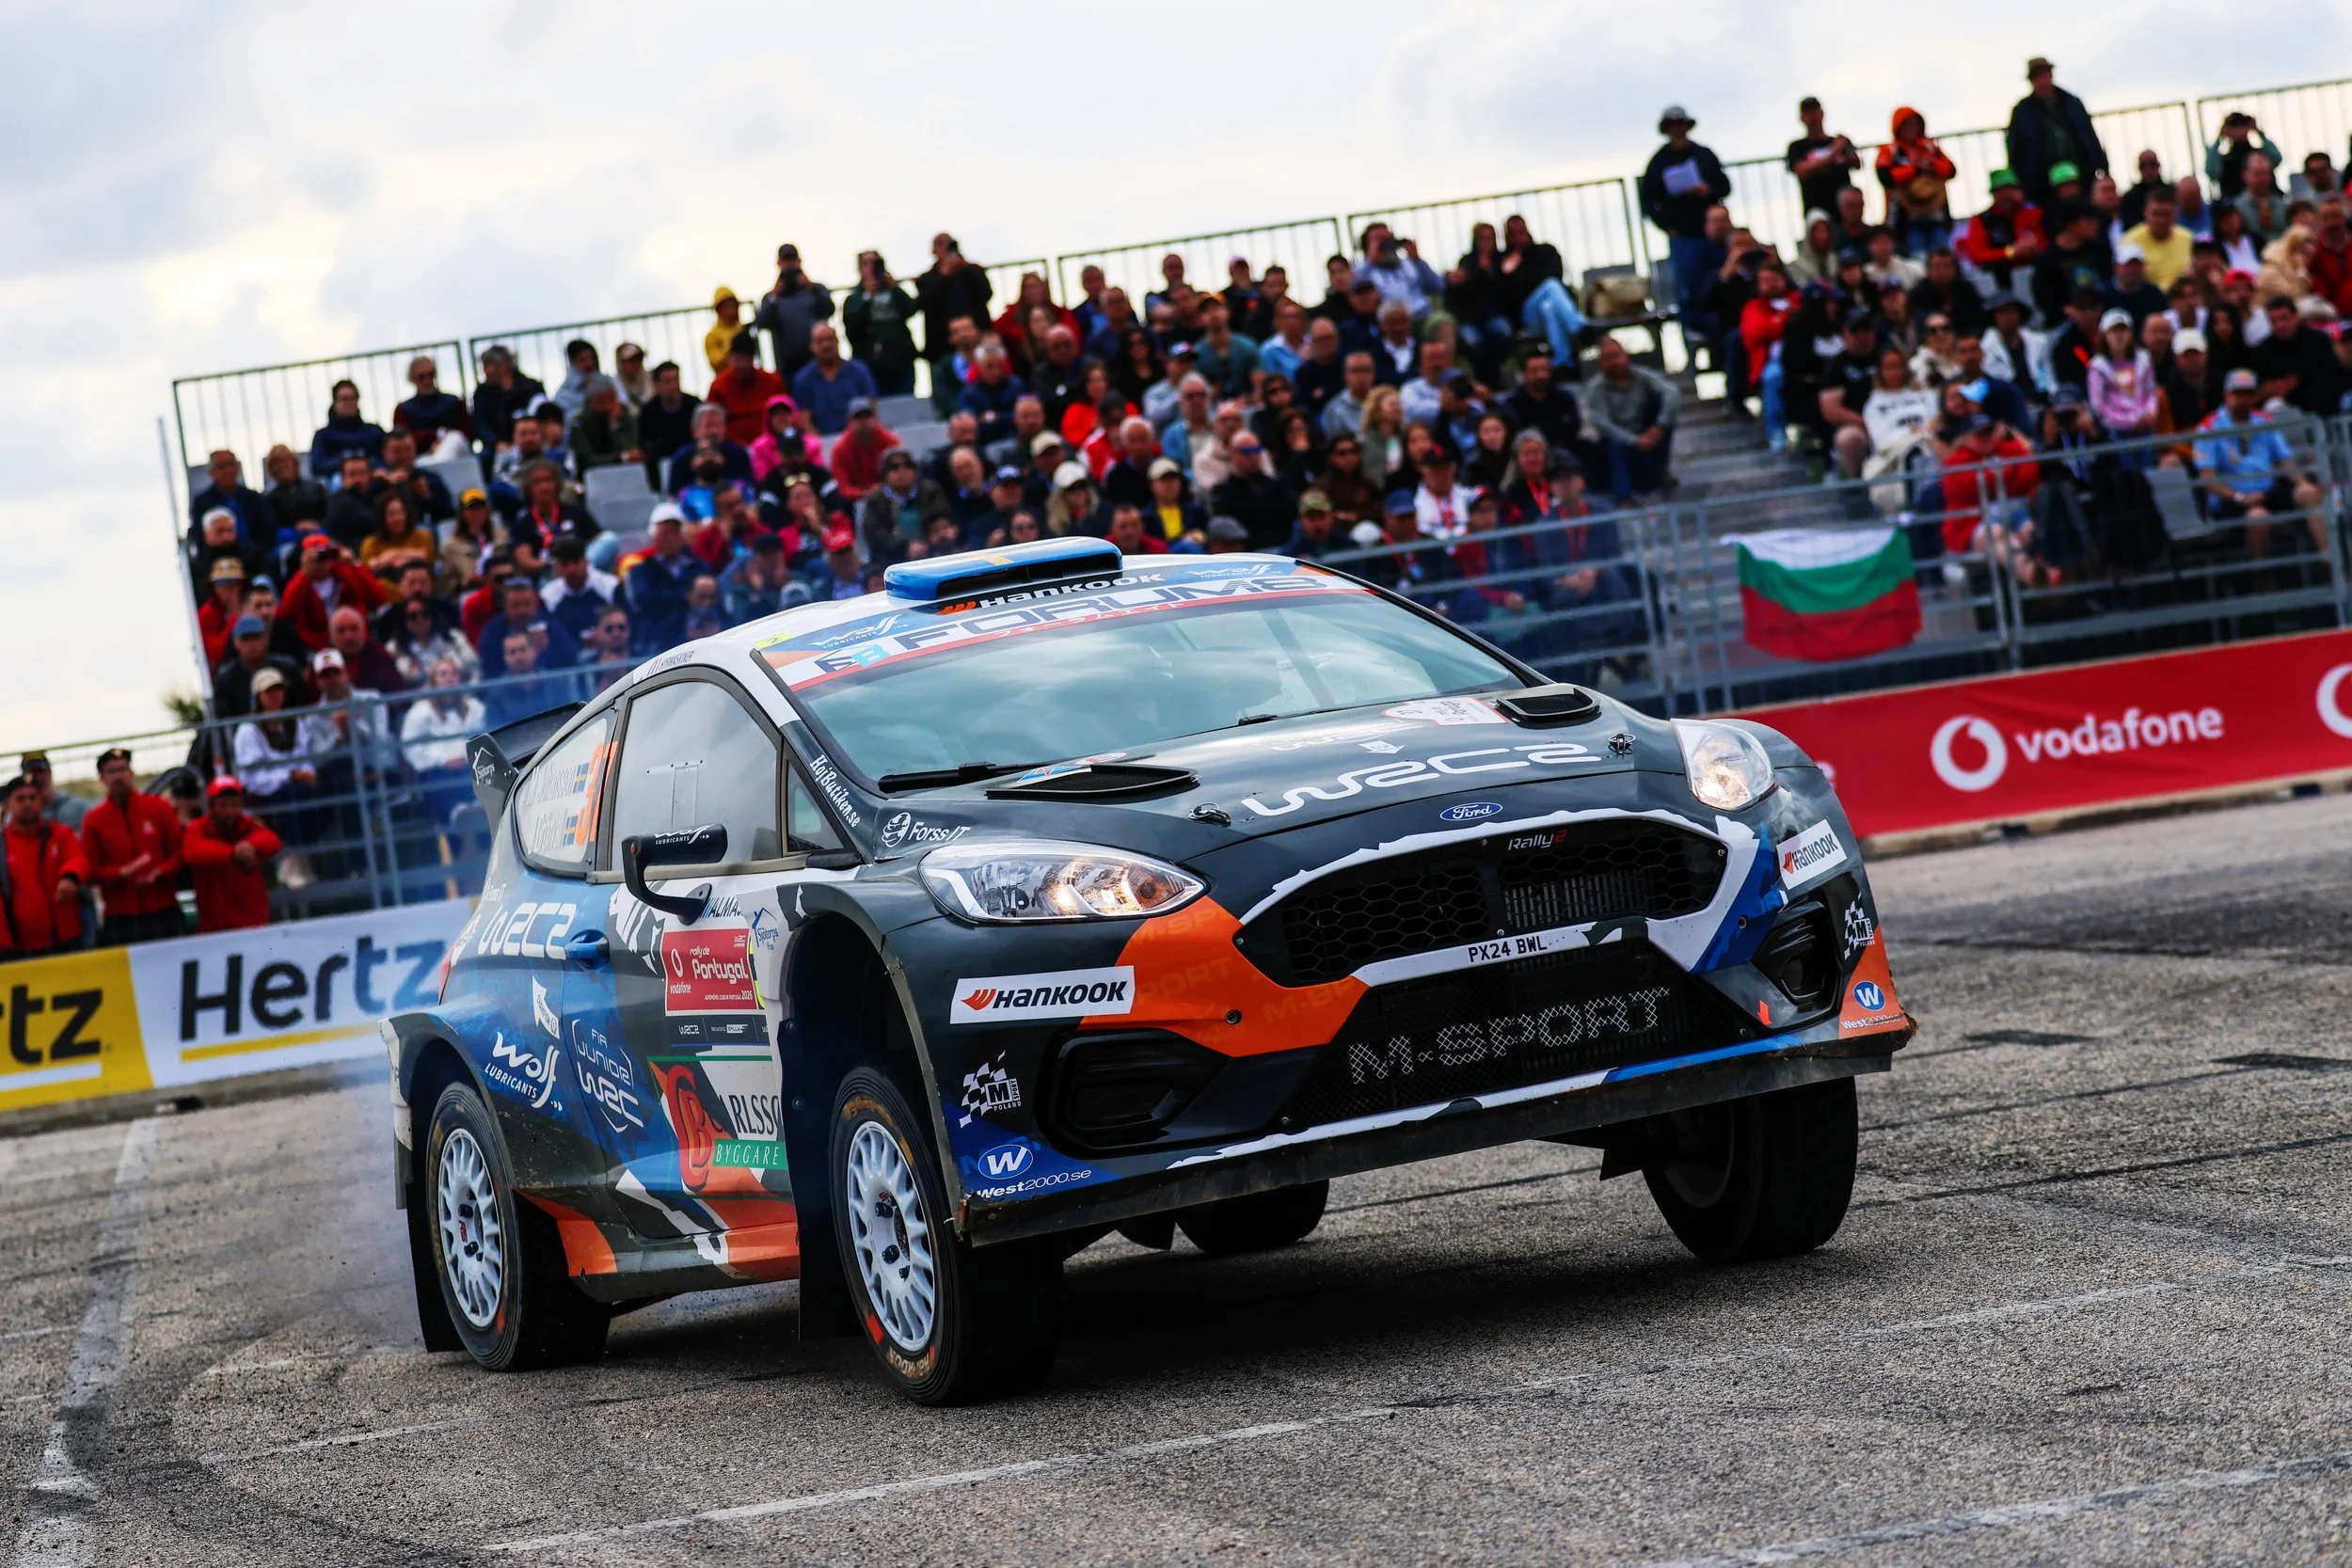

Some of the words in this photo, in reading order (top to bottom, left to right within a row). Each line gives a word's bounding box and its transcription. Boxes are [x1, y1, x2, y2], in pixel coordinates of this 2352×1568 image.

[894, 577, 1327, 651] FORUM8
[2015, 706, 2225, 763] vodafone
[1241, 743, 1601, 816] WRC2
[1453, 804, 1493, 820] Ford
[656, 835, 691, 845] LUBRICANTS
[907, 821, 949, 842] Forss
[946, 826, 972, 842] IT
[478, 902, 577, 960] WRC2
[690, 947, 703, 958] rally
[702, 946, 710, 955] de
[1469, 942, 1511, 962] PX24
[1516, 936, 1548, 955] BWL
[691, 958, 749, 985] Portugal
[178, 935, 445, 1043] Hertz
[670, 982, 691, 994] vodafone
[591, 1028, 608, 1048] FIA
[678, 1024, 700, 1035] WRC2
[1348, 987, 1670, 1085] M-SPORT
[577, 1040, 631, 1086] JUNIOR
[485, 1062, 538, 1099] LUBRICANTS
[578, 1061, 644, 1128] WRC
[993, 1101, 1022, 1112] POLAND
[716, 1144, 779, 1165] BYGGARE
[987, 1145, 1027, 1176] W
[977, 1170, 1092, 1198] West2000.se
